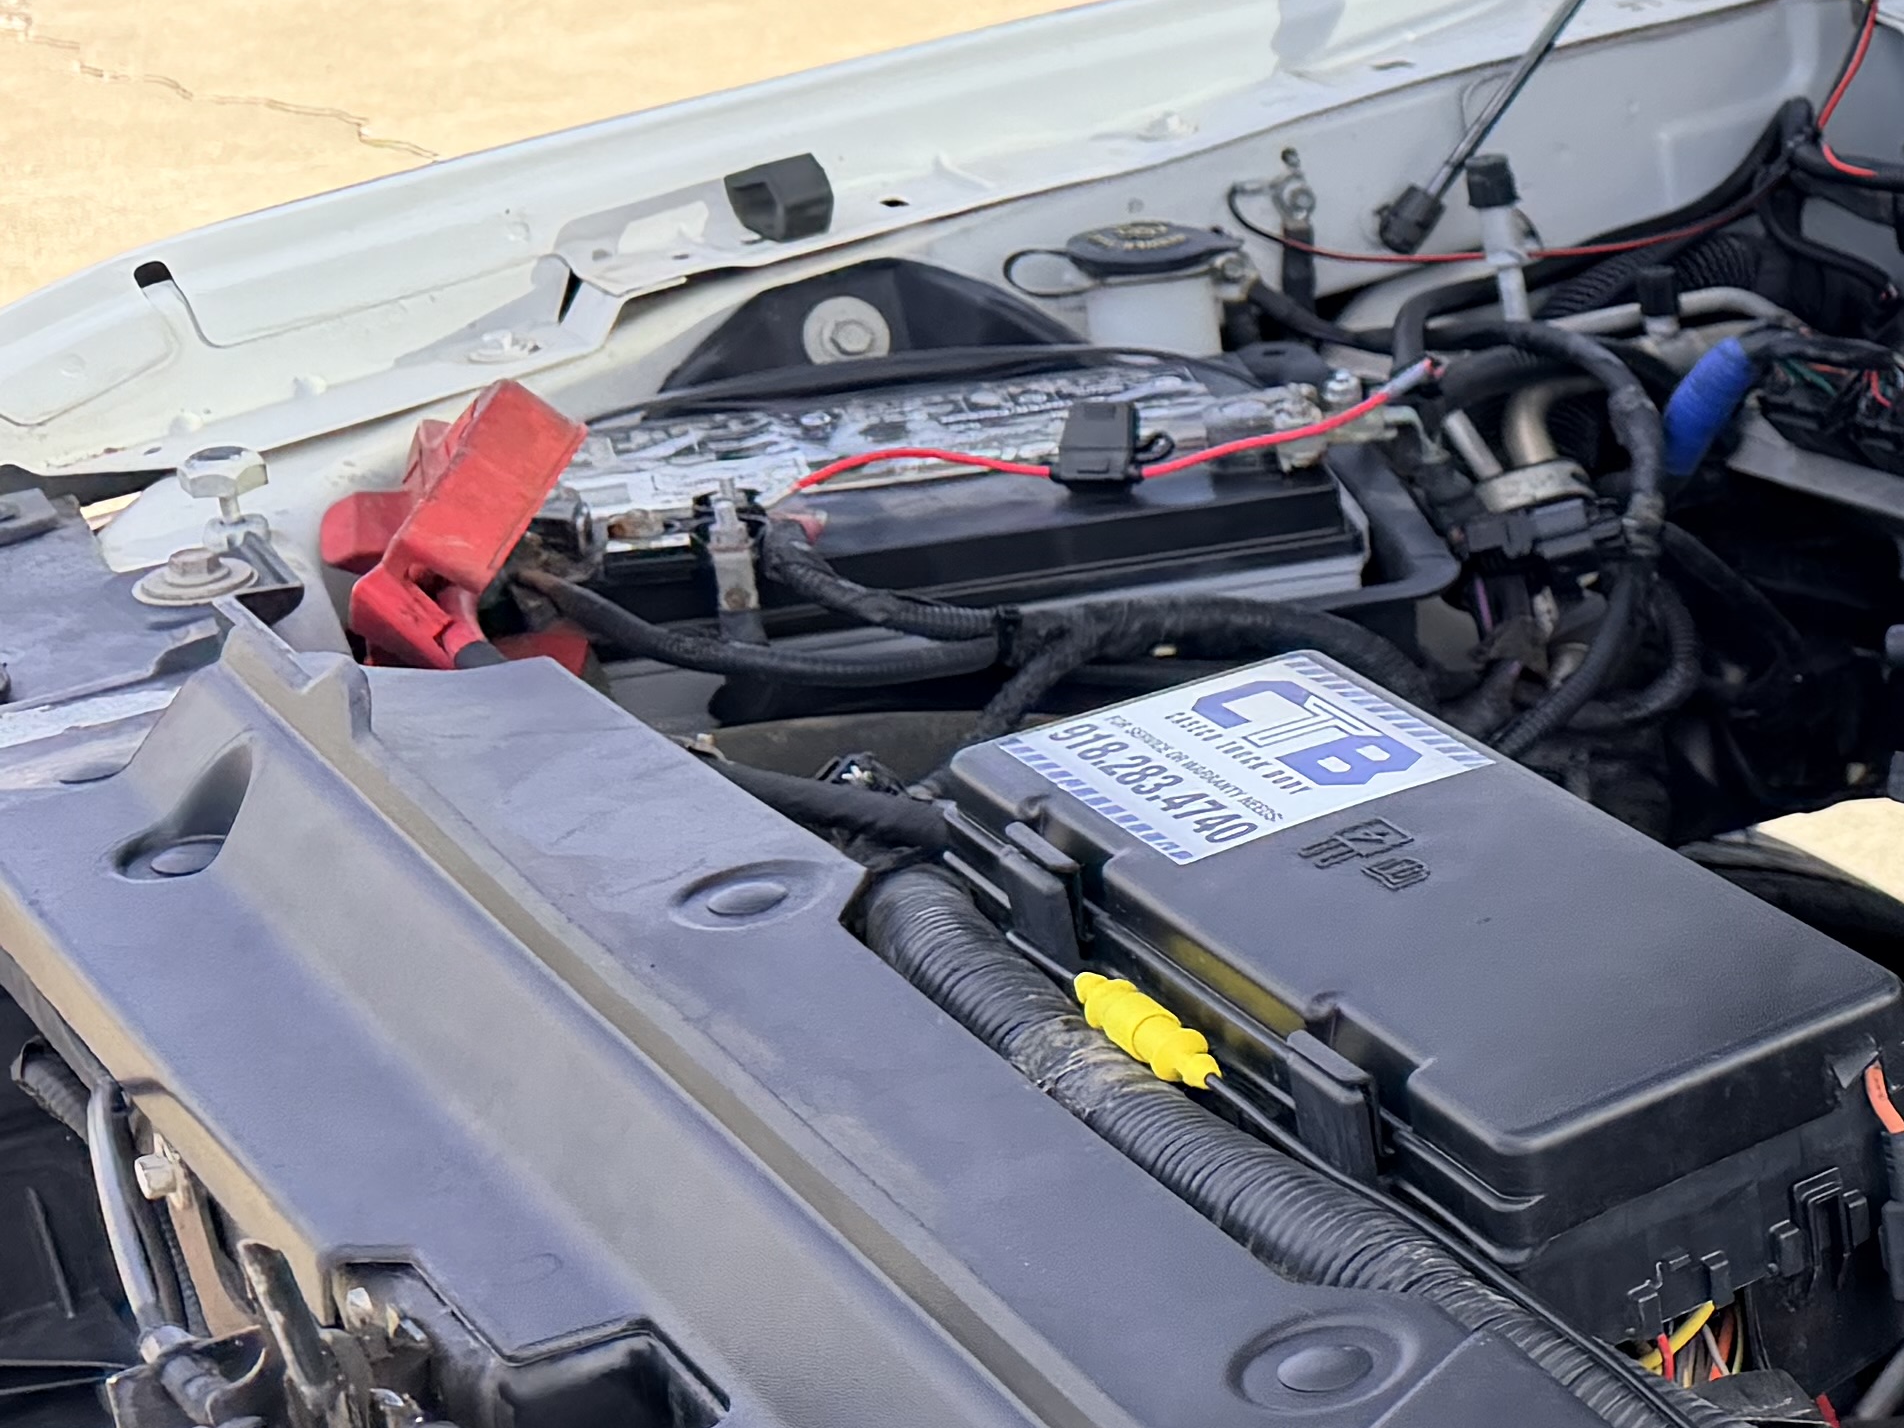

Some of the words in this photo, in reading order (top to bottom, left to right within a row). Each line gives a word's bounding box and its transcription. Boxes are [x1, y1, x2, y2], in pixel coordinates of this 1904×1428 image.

[1105, 714, 1131, 729] FOR
[1125, 725, 1171, 755] SERVICE
[1180, 758, 1244, 799] WARRANTY
[1191, 680, 1423, 785] CTB
[1214, 740, 1273, 771] TRUCK
[1261, 769, 1313, 795] BODY
[1048, 722, 1259, 844] 918.283.4740
